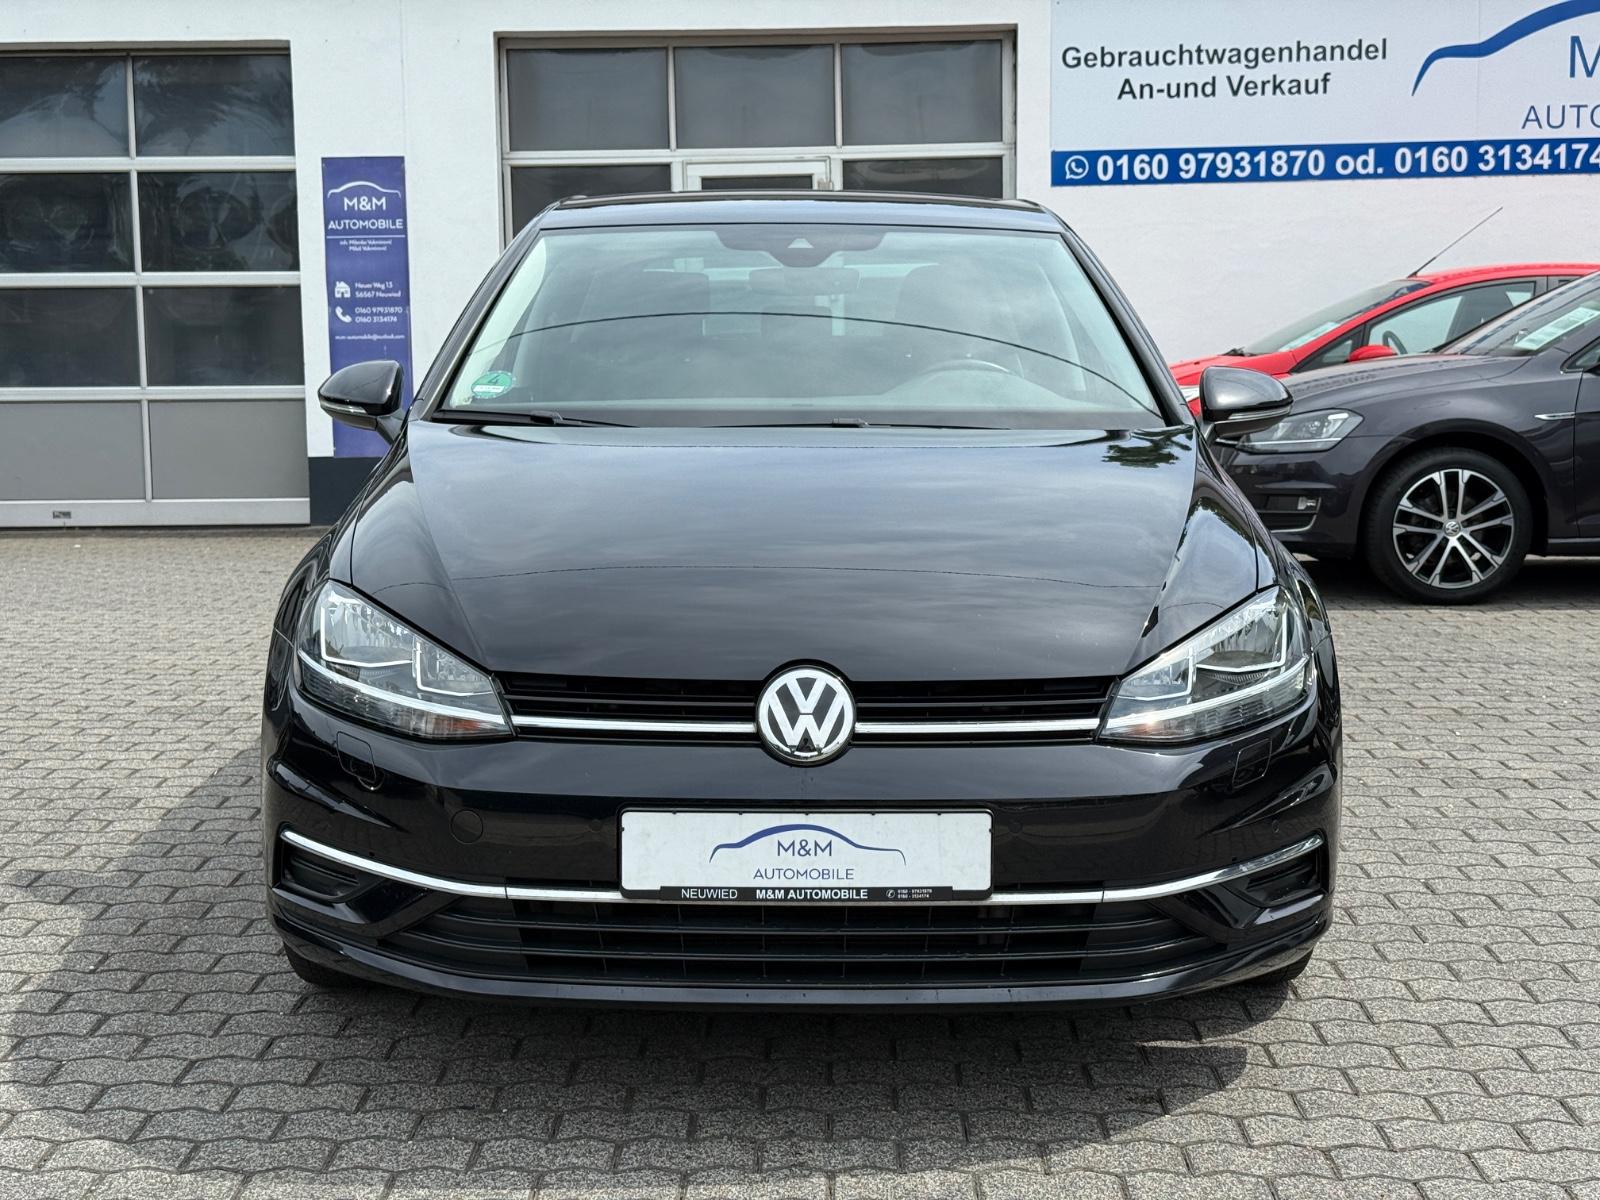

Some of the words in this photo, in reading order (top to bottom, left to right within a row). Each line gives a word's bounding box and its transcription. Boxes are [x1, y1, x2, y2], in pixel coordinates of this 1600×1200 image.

[1061, 38, 1388, 69] Gebrauchtwagenhandel
[1117, 76, 1217, 101] An-und
[1226, 72, 1331, 98] Verkauf
[1096, 154, 1169, 181] 0160
[1178, 150, 1325, 179] 97931870
[1335, 152, 1384, 176] od.
[1394, 147, 1468, 175] 0160
[344, 196, 387, 211] M&M
[328, 219, 404, 230] AUTOMOBILE
[761, 670, 852, 757] VW
[777, 839, 832, 857] M&M
[753, 868, 855, 880] AUTOMOBILE
[681, 888, 738, 899] NEUWIED
[756, 889, 784, 900] M&M
[787, 889, 868, 900] AUTOMOBILE
